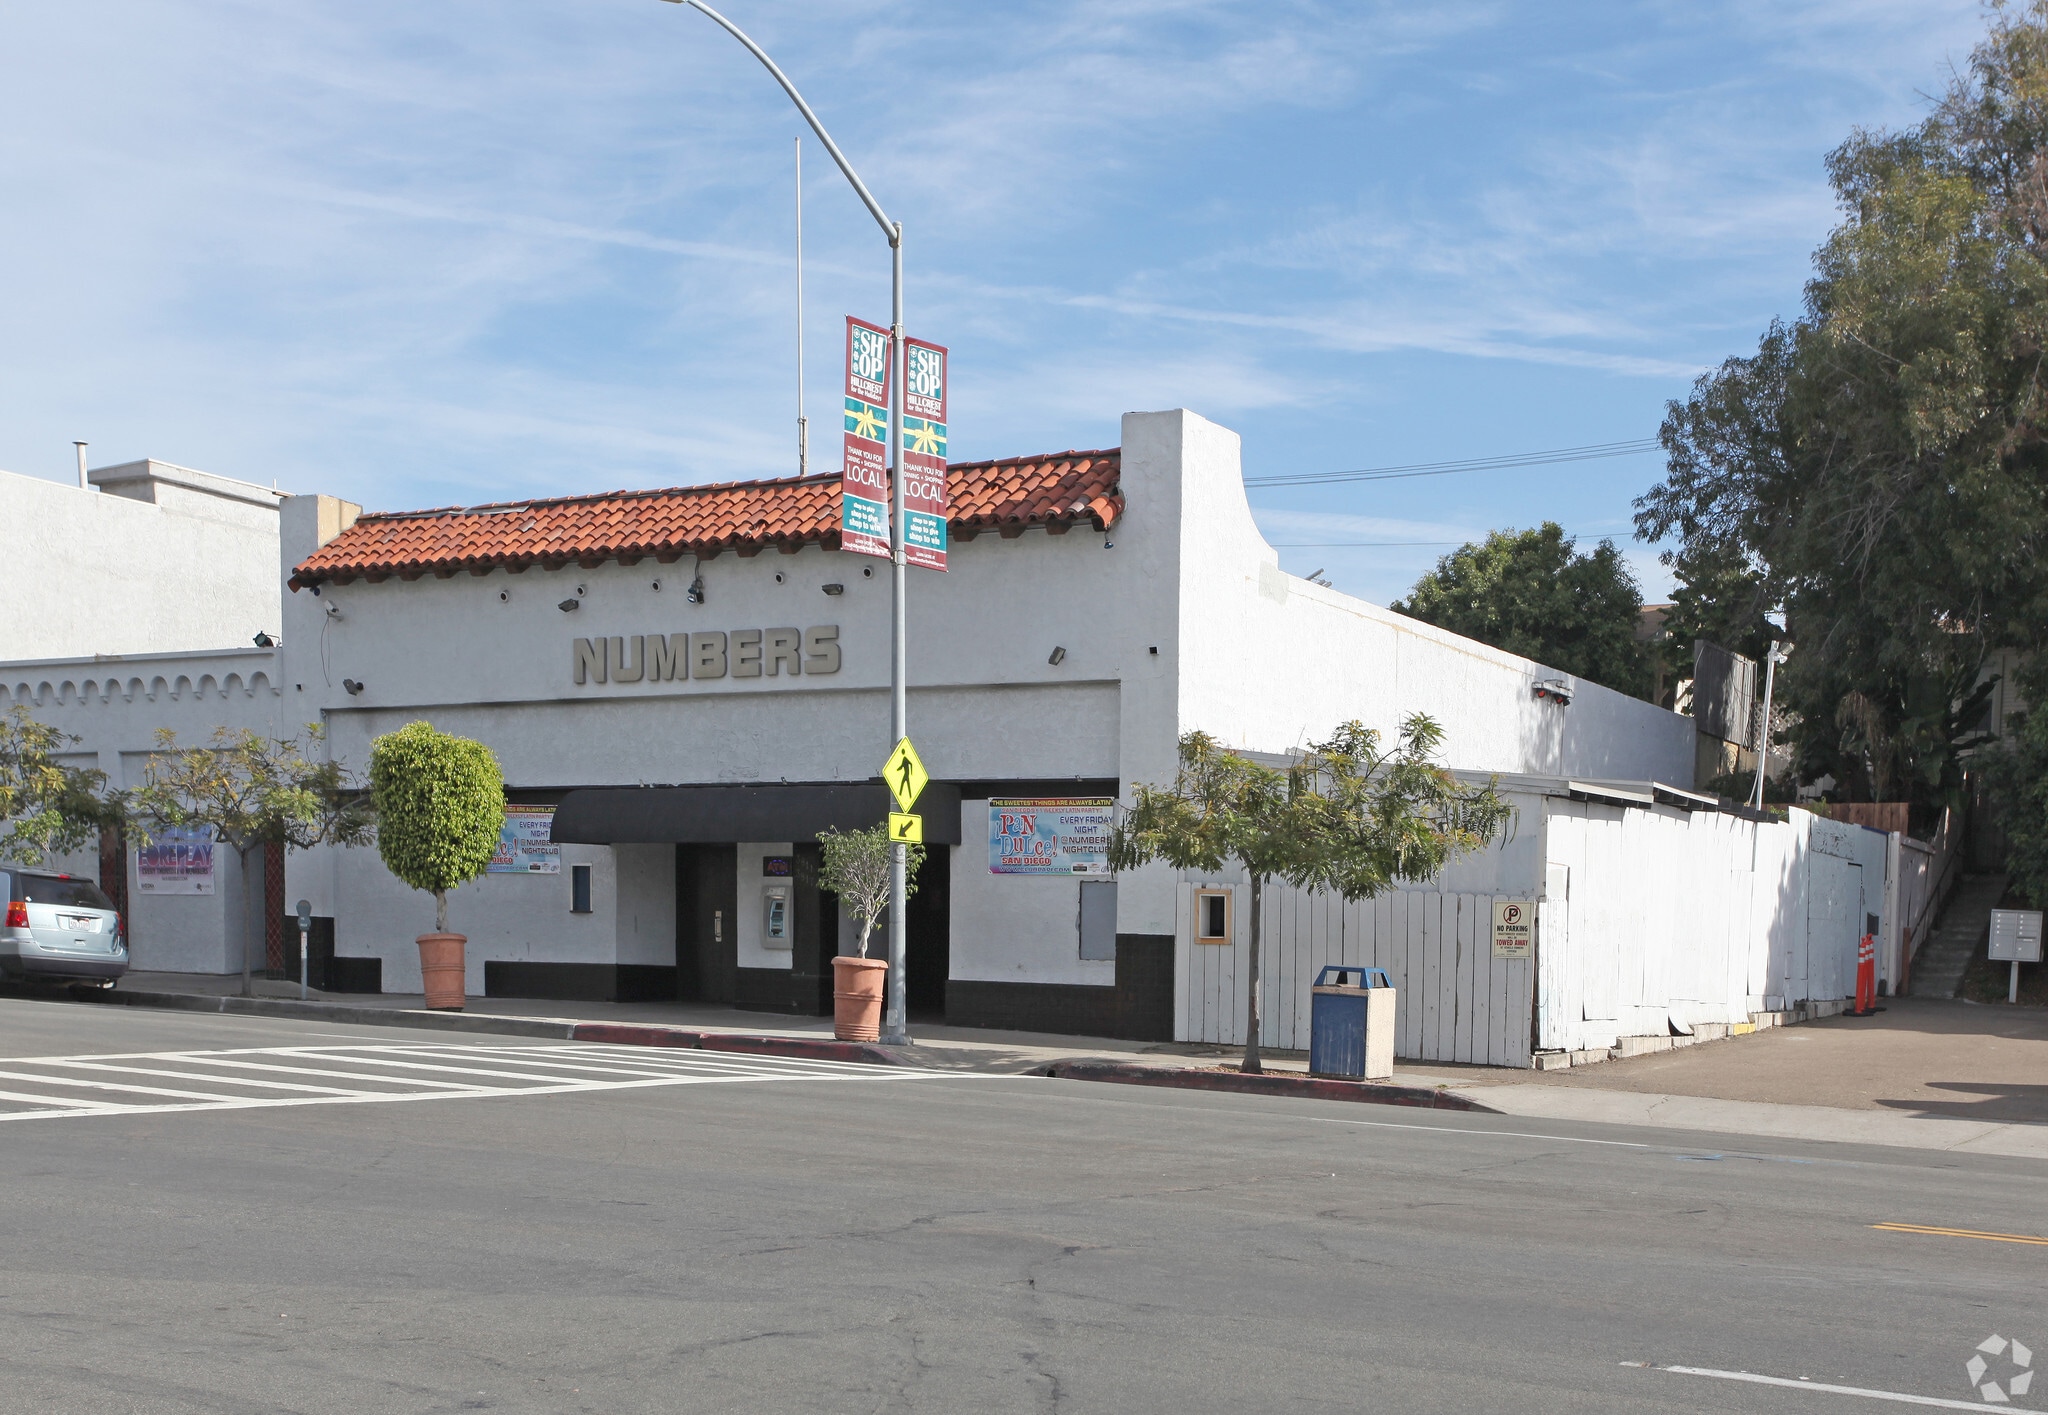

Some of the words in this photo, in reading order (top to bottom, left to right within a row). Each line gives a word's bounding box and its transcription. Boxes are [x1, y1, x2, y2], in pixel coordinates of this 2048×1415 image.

[851, 376, 883, 395] HILLCREST
[907, 394, 942, 411] HILLCREST
[847, 446, 862, 457] THANK
[863, 451, 872, 460] YOU
[873, 454, 882, 463] FOR
[864, 460, 883, 471] SHOPPING
[904, 463, 922, 472] THANK
[923, 466, 934, 475] YOU
[935, 469, 943, 478] FOR
[847, 463, 883, 489] LOCAL
[904, 472, 919, 480] DINING
[925, 475, 943, 485] SHOPPING
[904, 480, 944, 503] LOCAL
[573, 624, 841, 684] NUMBERS
[1060, 816, 1084, 824] EVERY
[1086, 816, 1113, 824] FRIDAY
[138, 844, 214, 867] FOREPLAY
[521, 847, 559, 855] NIGHTCLUB
[1002, 857, 1021, 866] SAN
[1024, 857, 1052, 866] DIEGO
